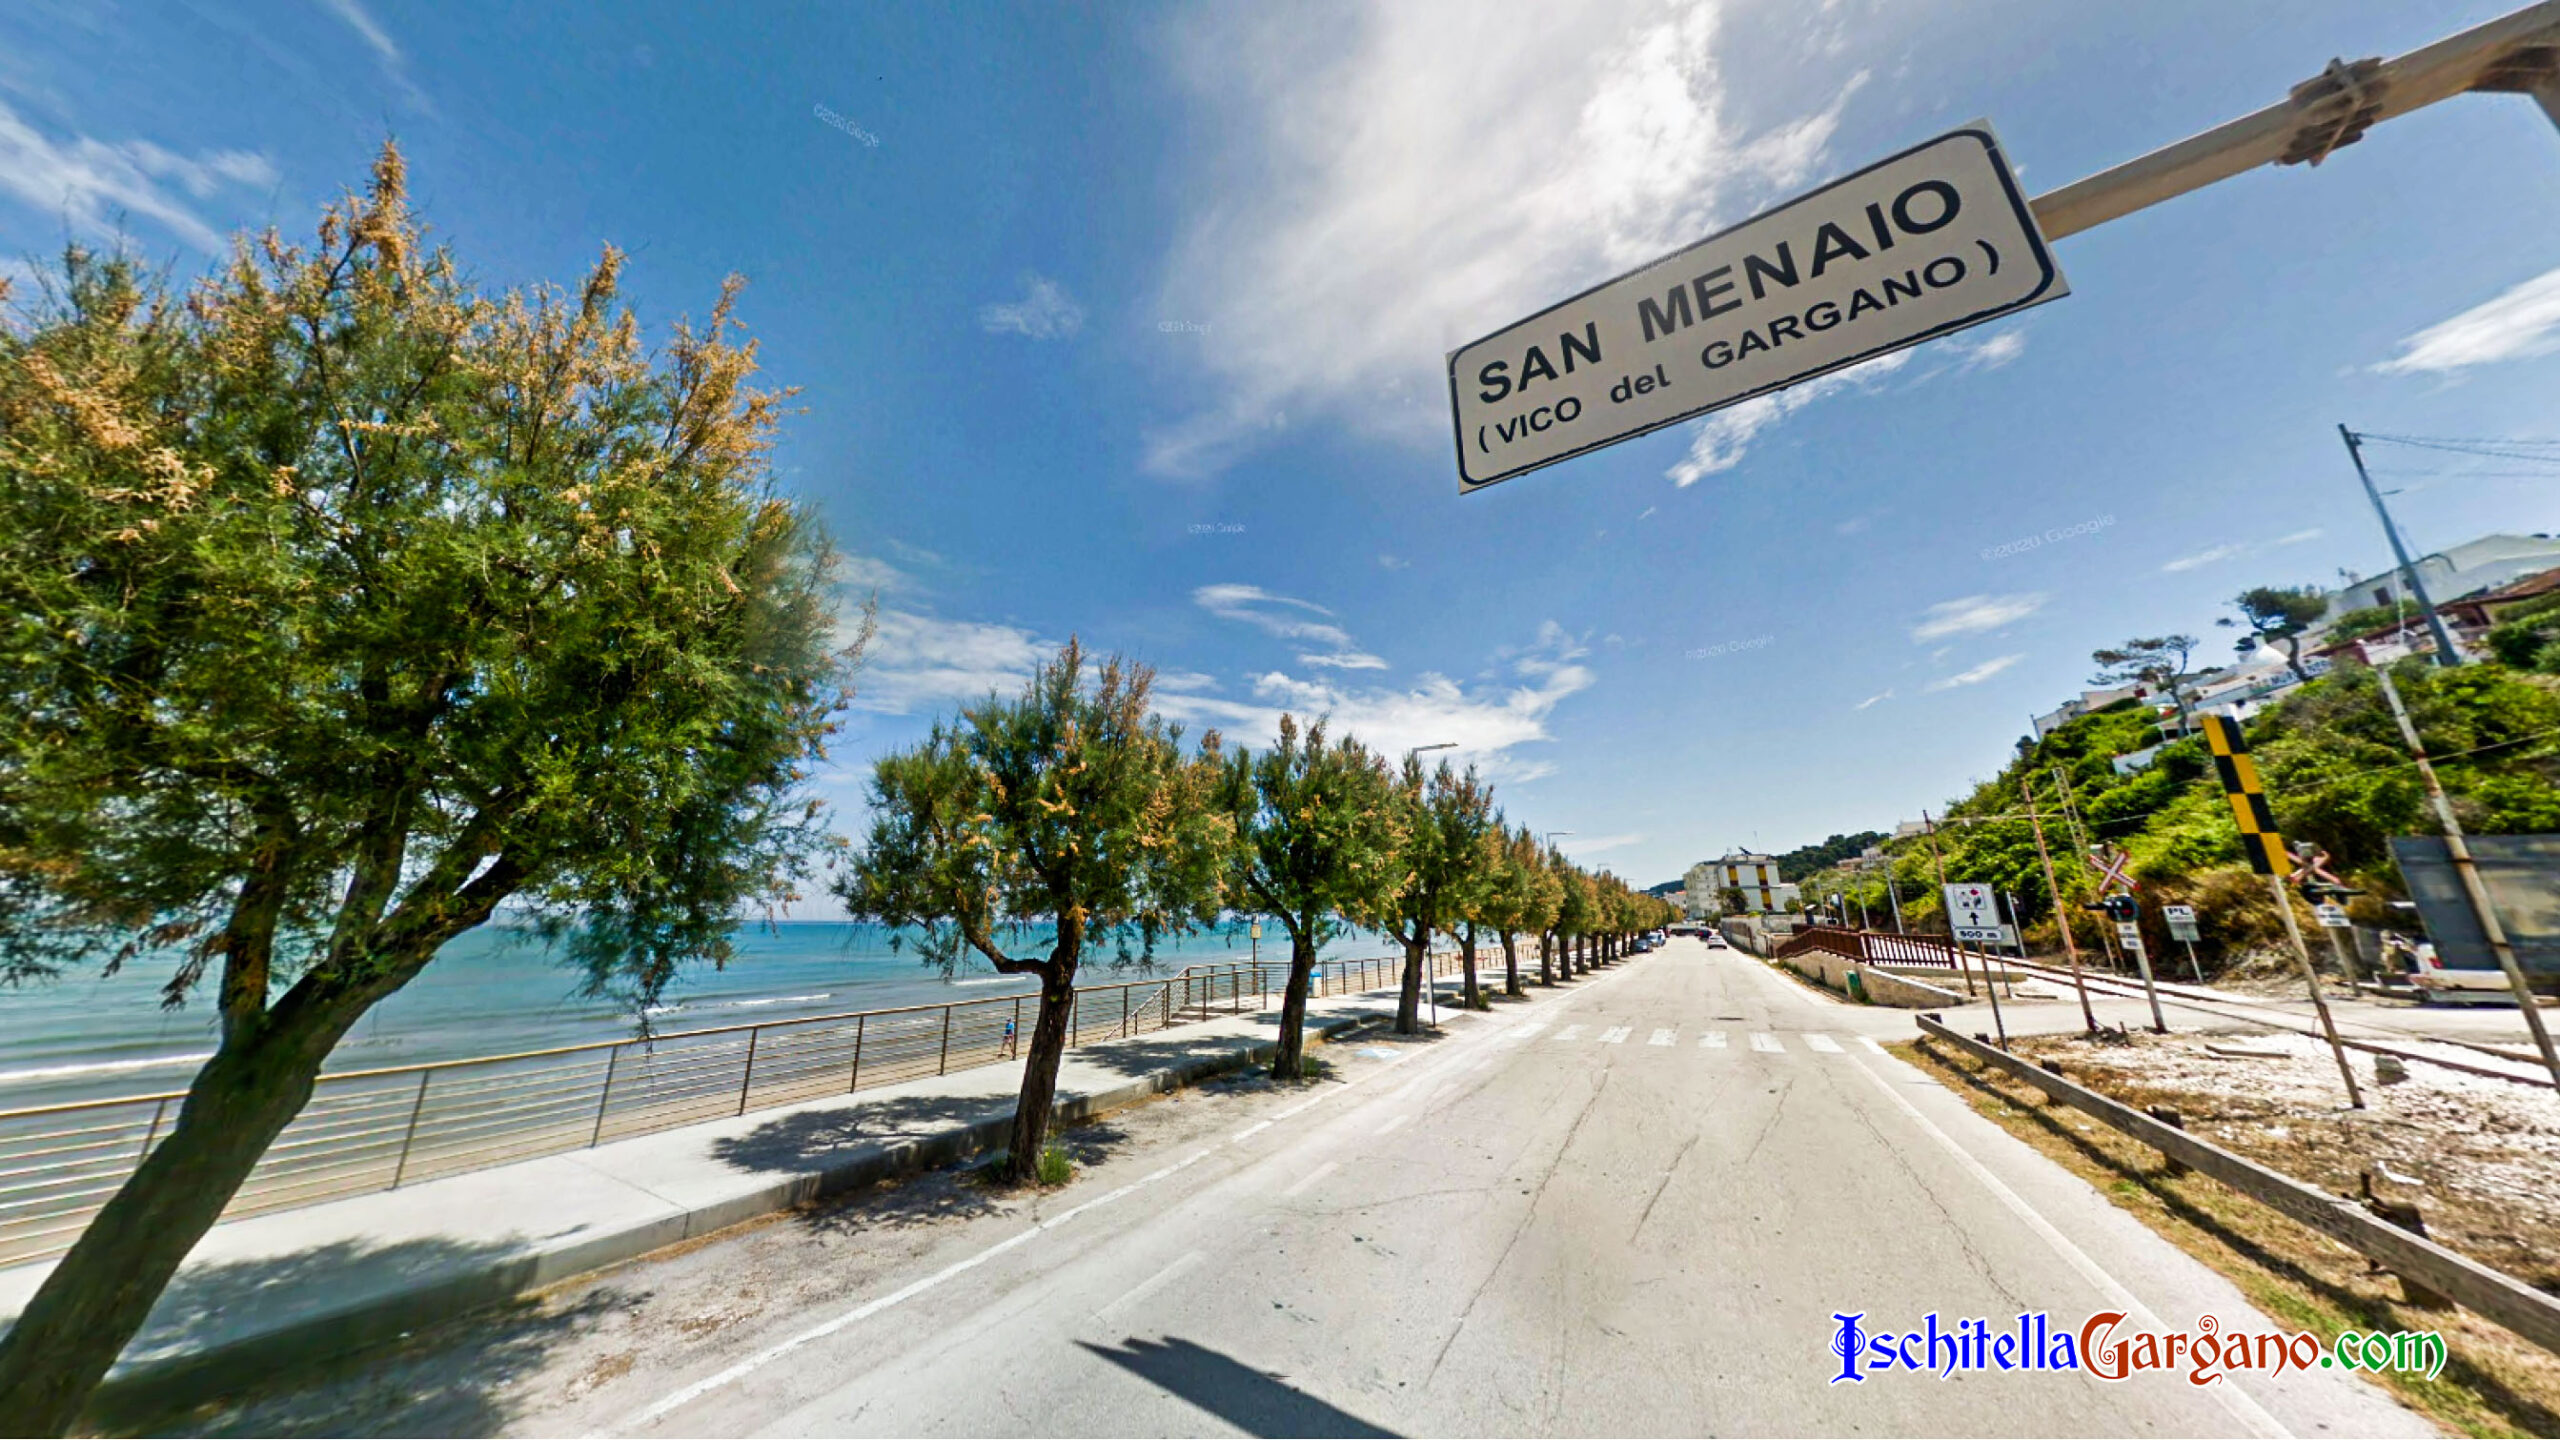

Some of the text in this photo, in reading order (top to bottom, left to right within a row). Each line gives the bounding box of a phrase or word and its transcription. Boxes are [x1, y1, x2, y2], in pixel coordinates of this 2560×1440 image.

[1478, 179, 1962, 404] SAN MENAIO
[1478, 396, 1582, 454] (VICO
[1609, 363, 1672, 405] del
